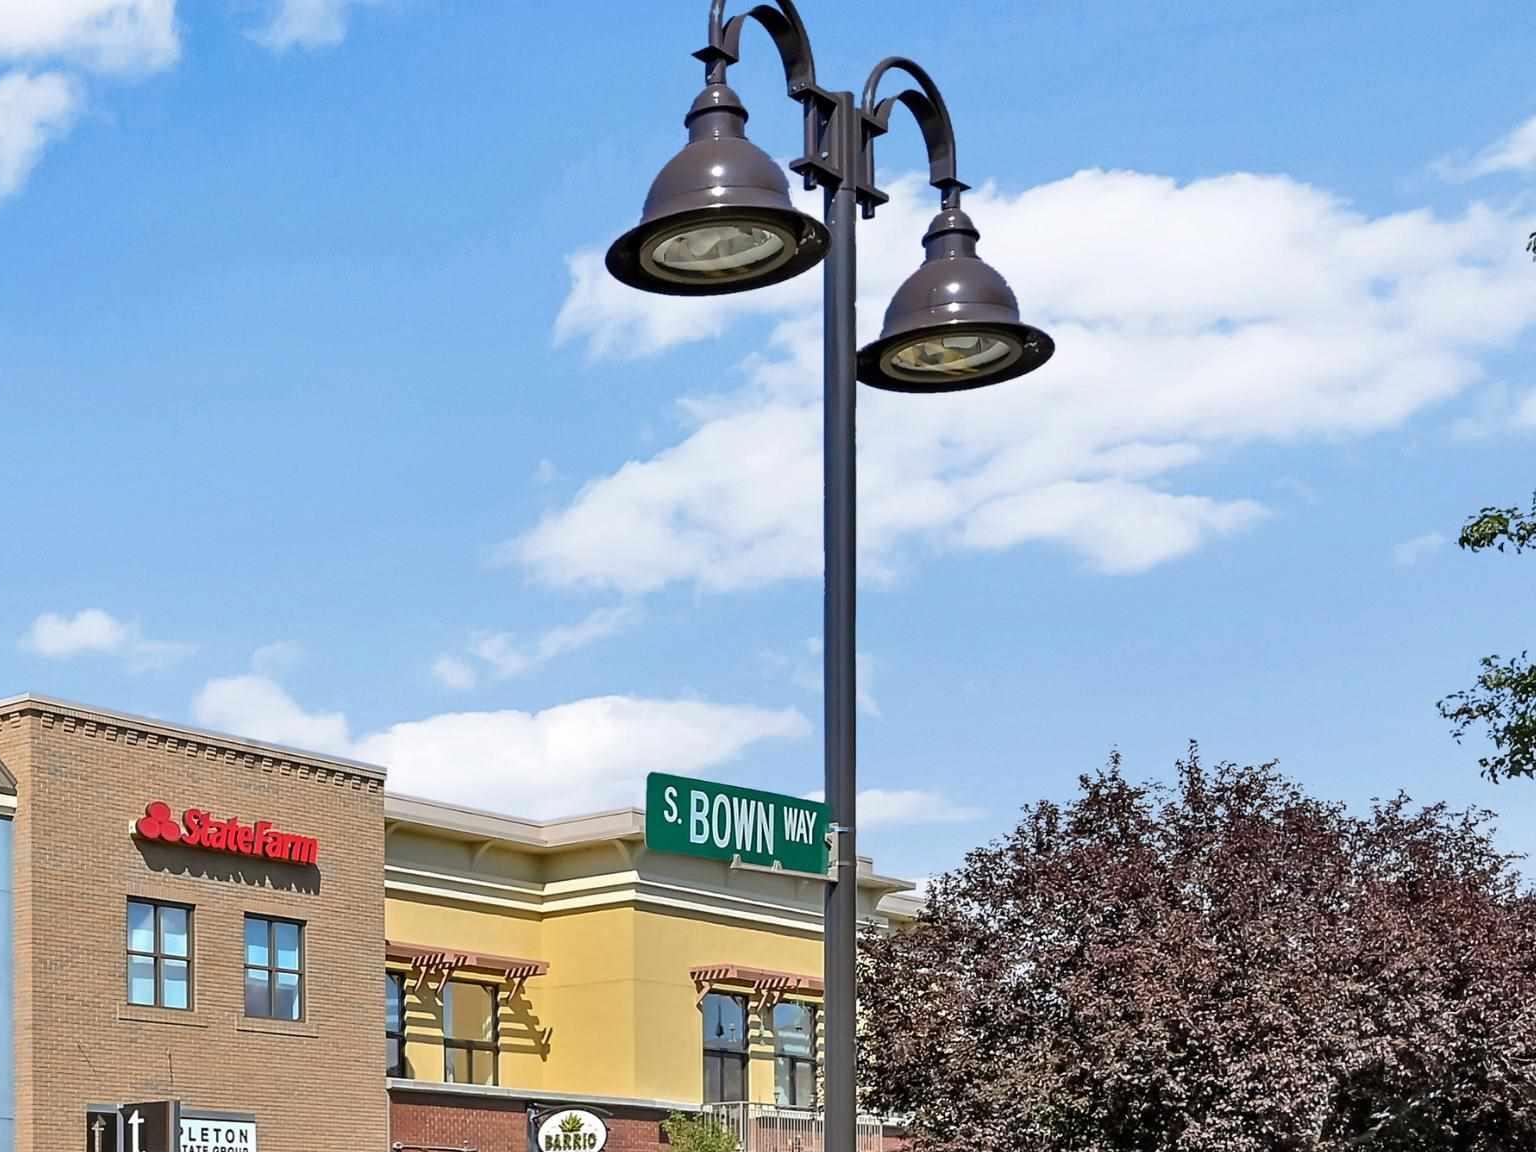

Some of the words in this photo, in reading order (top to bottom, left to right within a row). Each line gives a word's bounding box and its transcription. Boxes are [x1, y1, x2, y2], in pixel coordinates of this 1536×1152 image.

[663, 785, 683, 825] S.
[689, 789, 775, 855] BOWN
[783, 805, 817, 845] WAY
[544, 1132, 597, 1152] BARRIO
